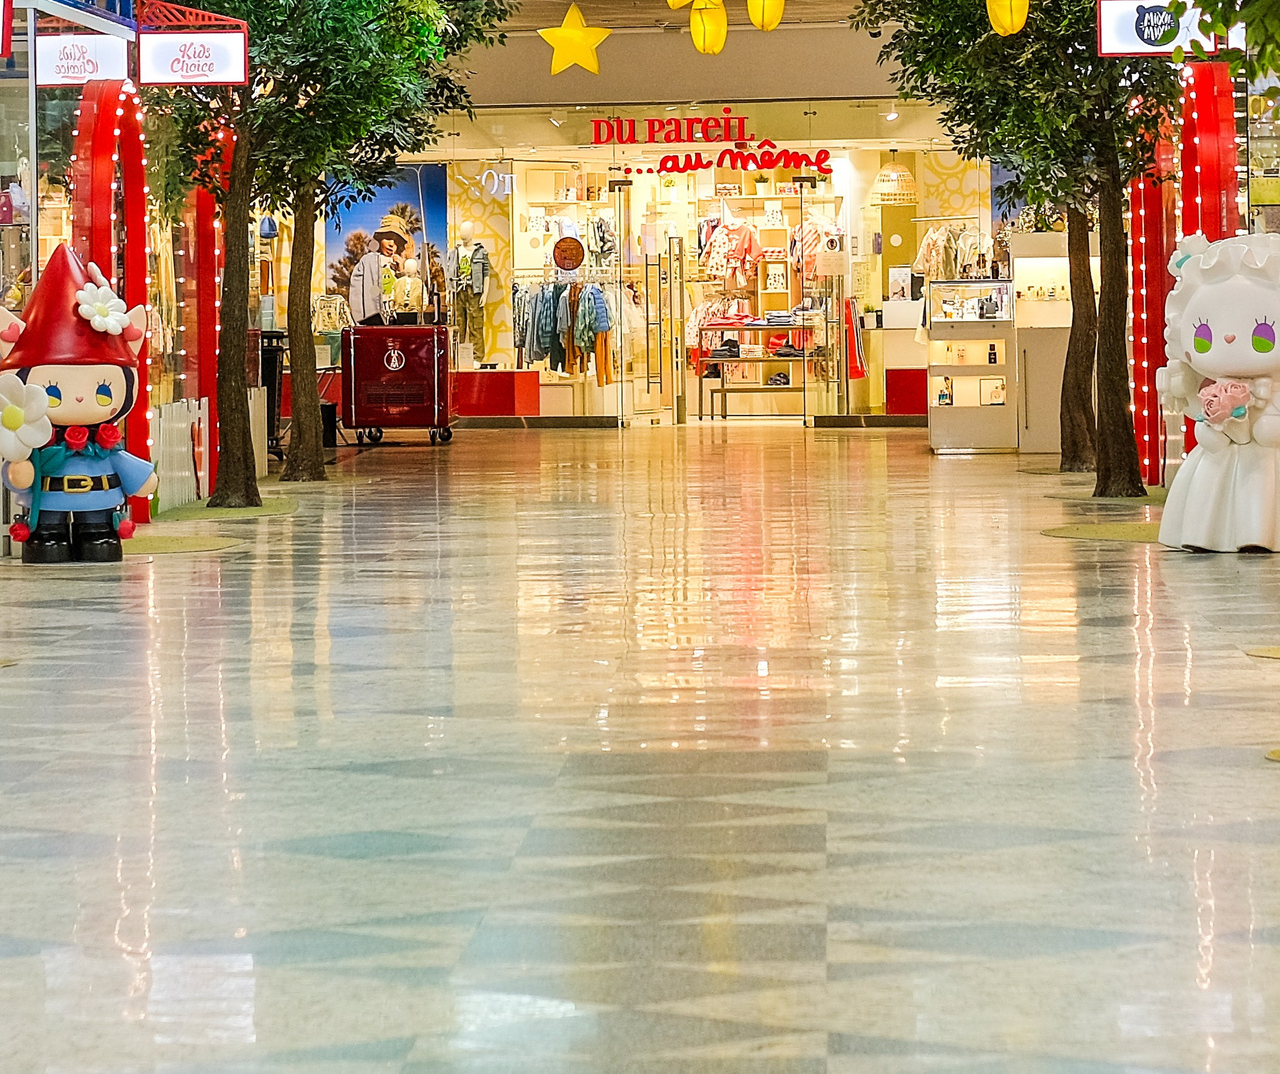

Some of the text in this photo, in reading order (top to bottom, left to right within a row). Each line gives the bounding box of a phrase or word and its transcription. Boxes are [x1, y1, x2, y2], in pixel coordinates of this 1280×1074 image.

[179, 42, 211, 60] Kids
[170, 57, 214, 73] Choice
[717, 139, 833, 174] même
